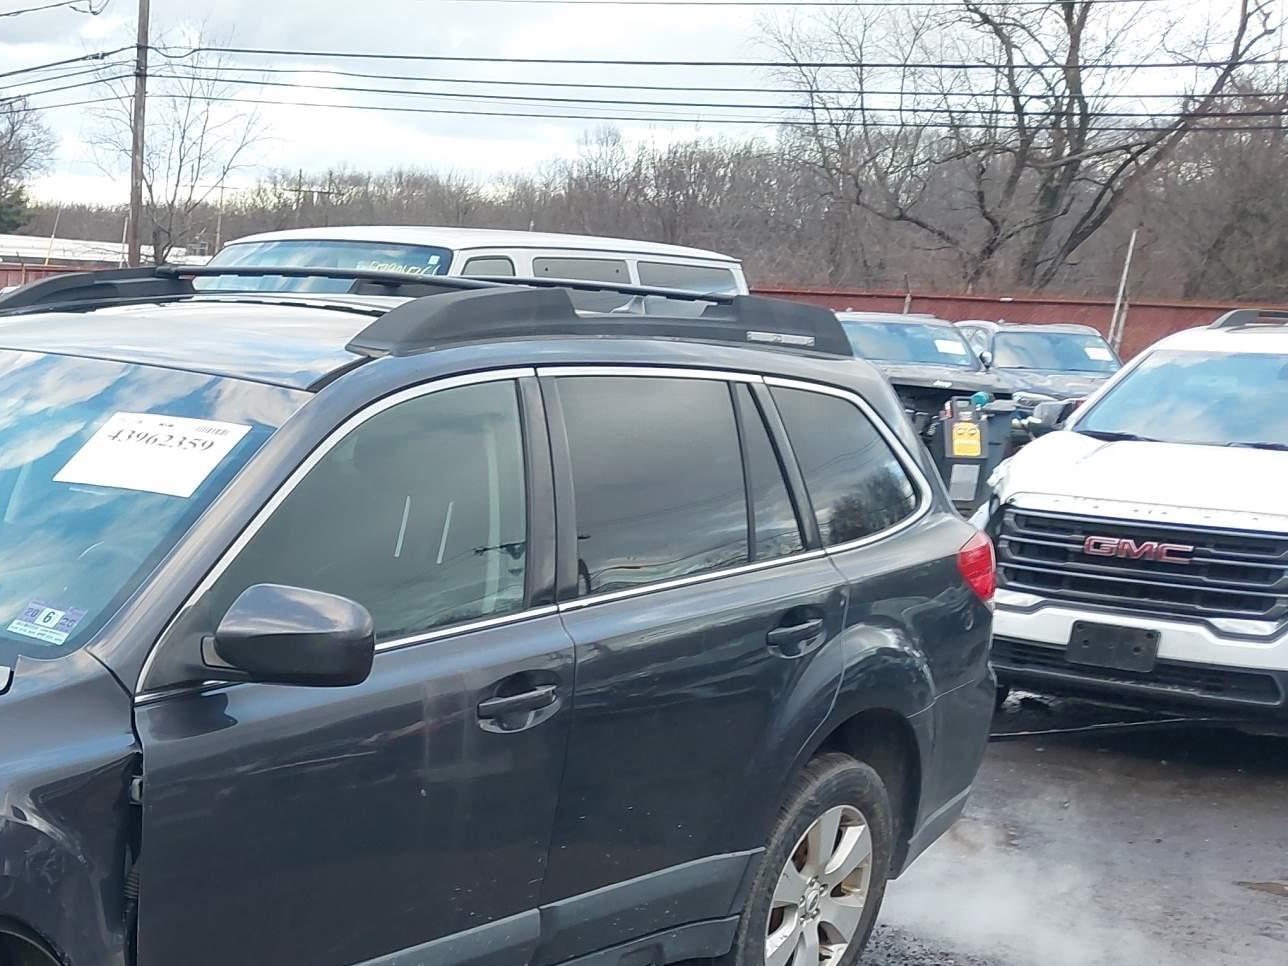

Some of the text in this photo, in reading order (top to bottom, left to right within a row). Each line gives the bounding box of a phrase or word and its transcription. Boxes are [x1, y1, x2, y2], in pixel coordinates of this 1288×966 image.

[107, 429, 215, 451] 43962359
[1083, 535, 1194, 564] GMC
[42, 611, 56, 623] 6
